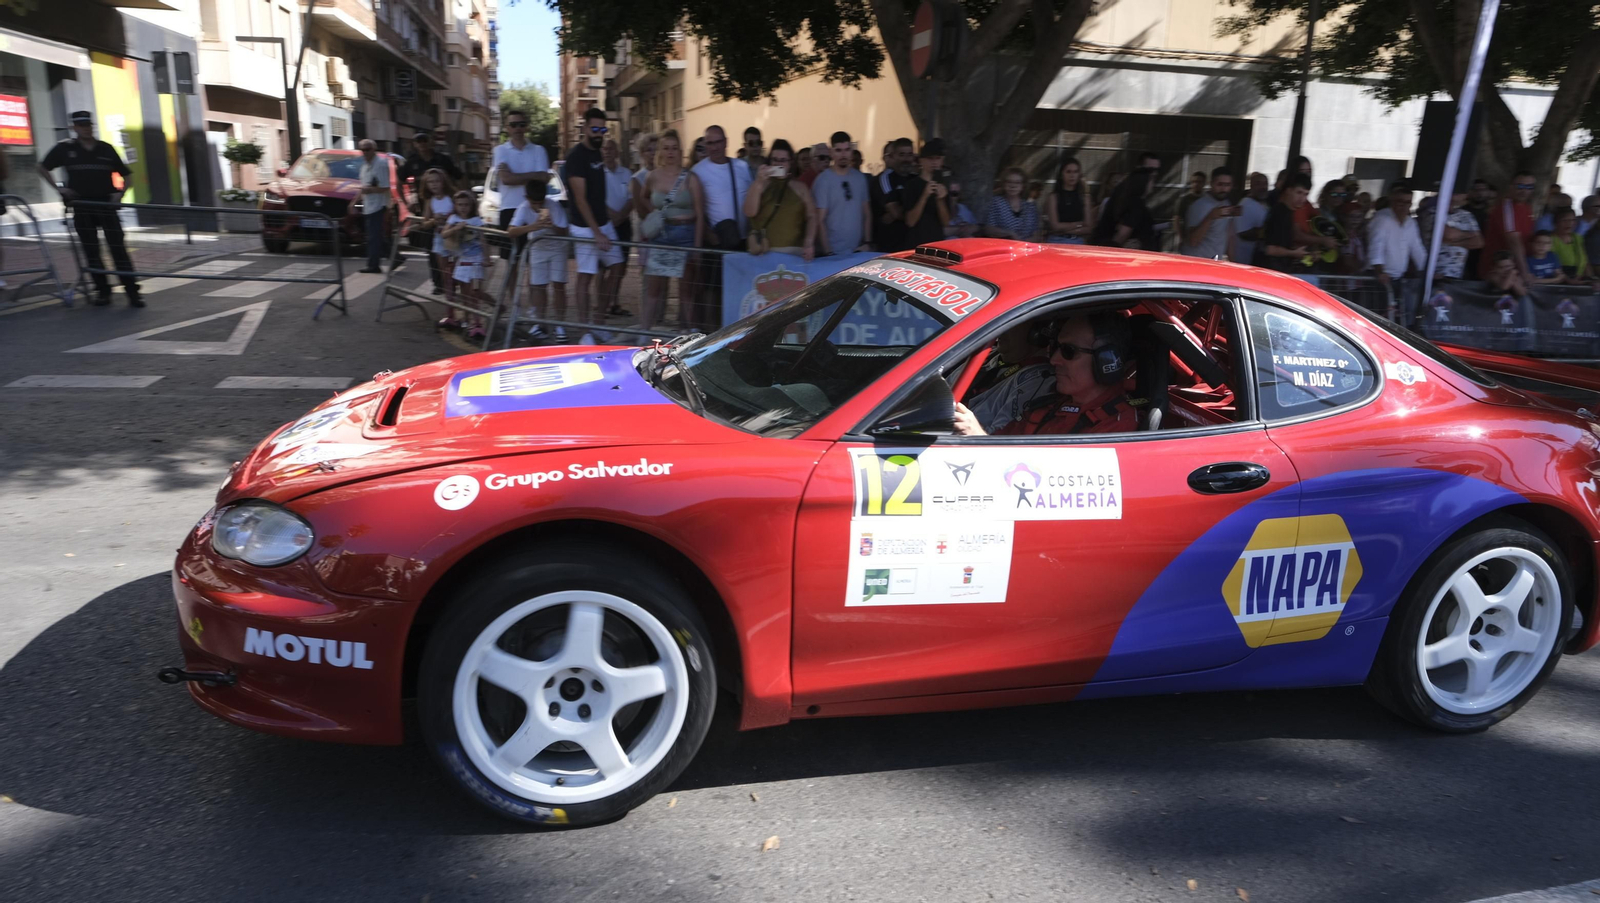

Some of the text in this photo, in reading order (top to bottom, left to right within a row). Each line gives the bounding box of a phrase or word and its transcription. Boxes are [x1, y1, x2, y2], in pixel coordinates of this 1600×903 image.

[878, 267, 982, 317] COSTASOL
[1272, 354, 1282, 365] F.
[1283, 356, 1338, 368] MARTINEZ
[1292, 371, 1308, 387] M.
[1308, 369, 1335, 387] DÍAZ
[484, 458, 674, 490] Grupo Salvador
[860, 454, 922, 516] 12
[1048, 474, 1115, 487] COSTA DE
[932, 496, 994, 504] CUPRA
[1035, 487, 1118, 509] ALMERÍA
[957, 531, 1007, 545] ALMERÍA
[1245, 549, 1342, 616] NAPA
[243, 627, 374, 670] MOTUL
